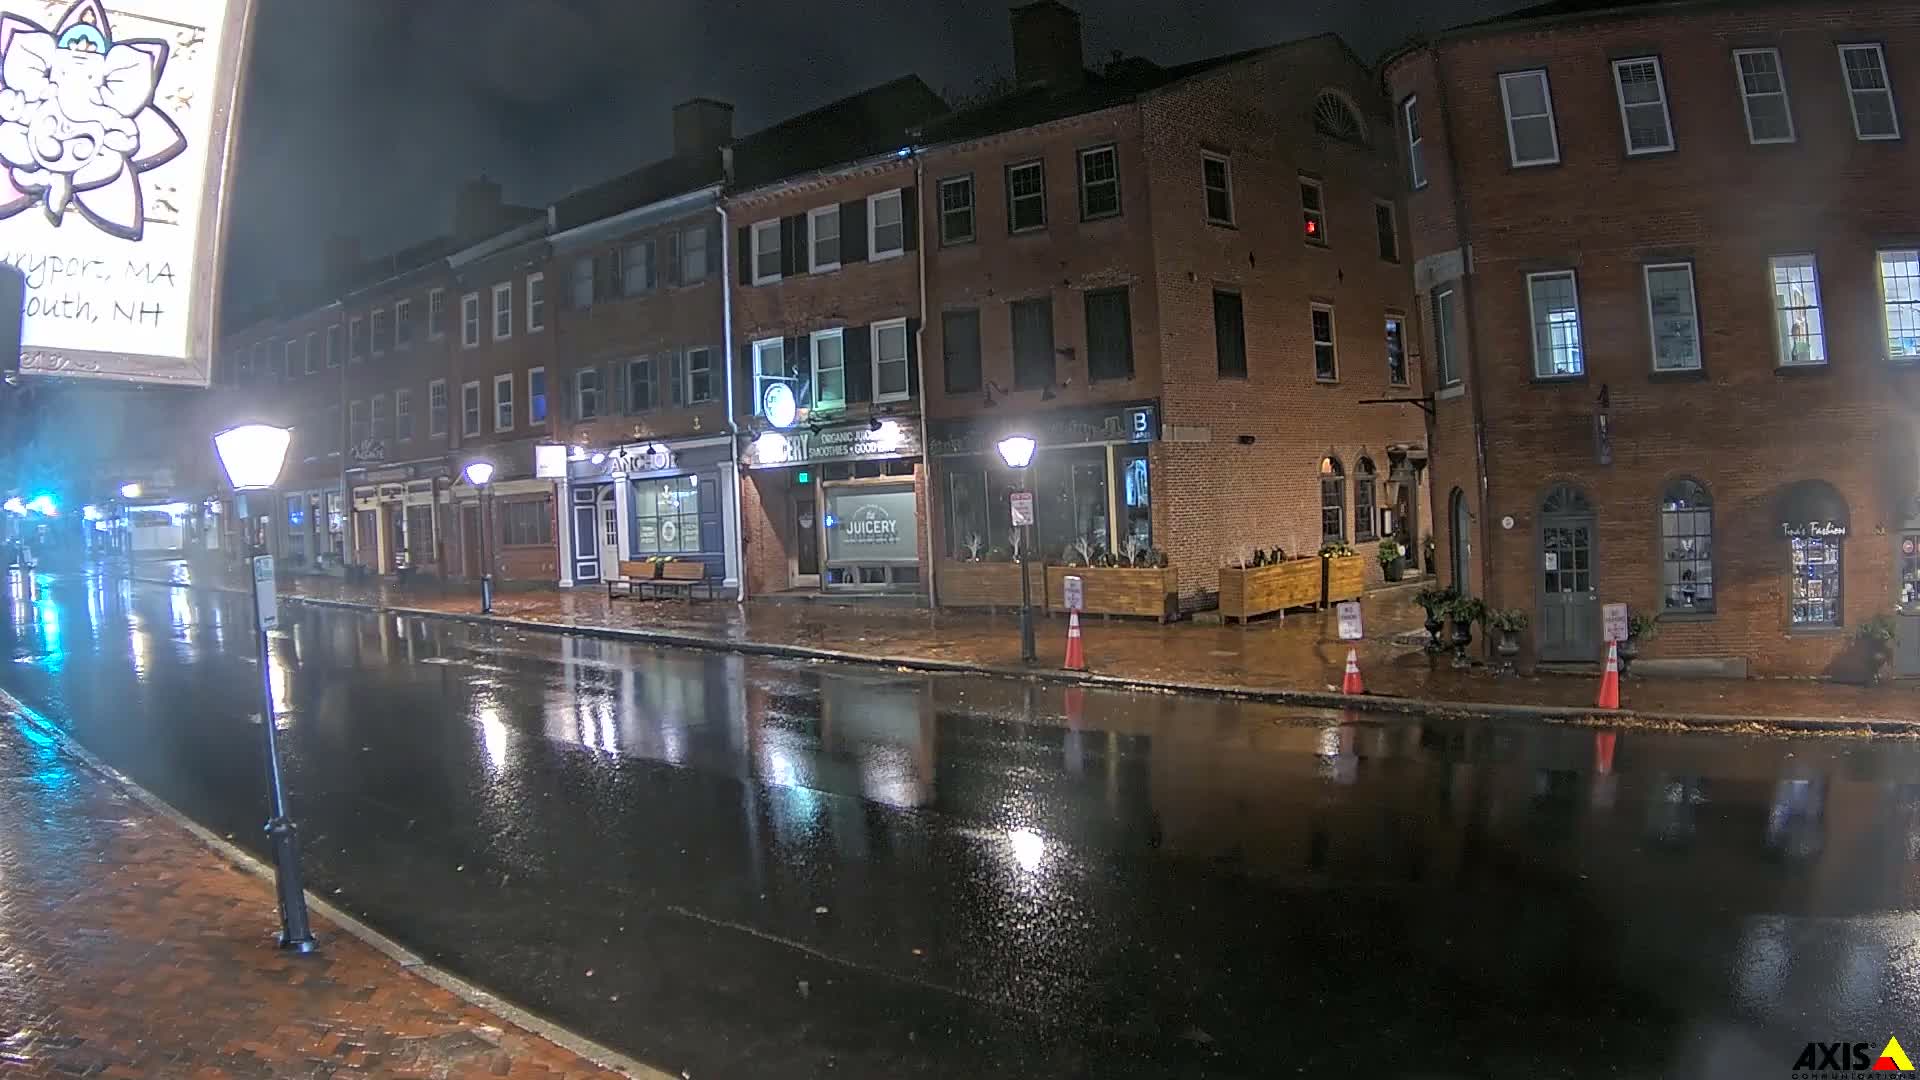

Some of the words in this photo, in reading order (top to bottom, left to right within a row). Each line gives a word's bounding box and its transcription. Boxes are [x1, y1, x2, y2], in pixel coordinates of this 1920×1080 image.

[125, 260, 175, 287] MA
[113, 301, 164, 328] NH
[1134, 412, 1147, 432] B
[821, 431, 854, 445] ORGANIC
[808, 445, 849, 458] SMOOTHIES
[854, 442, 877, 454] GOOD
[846, 520, 897, 534] JUICERY
